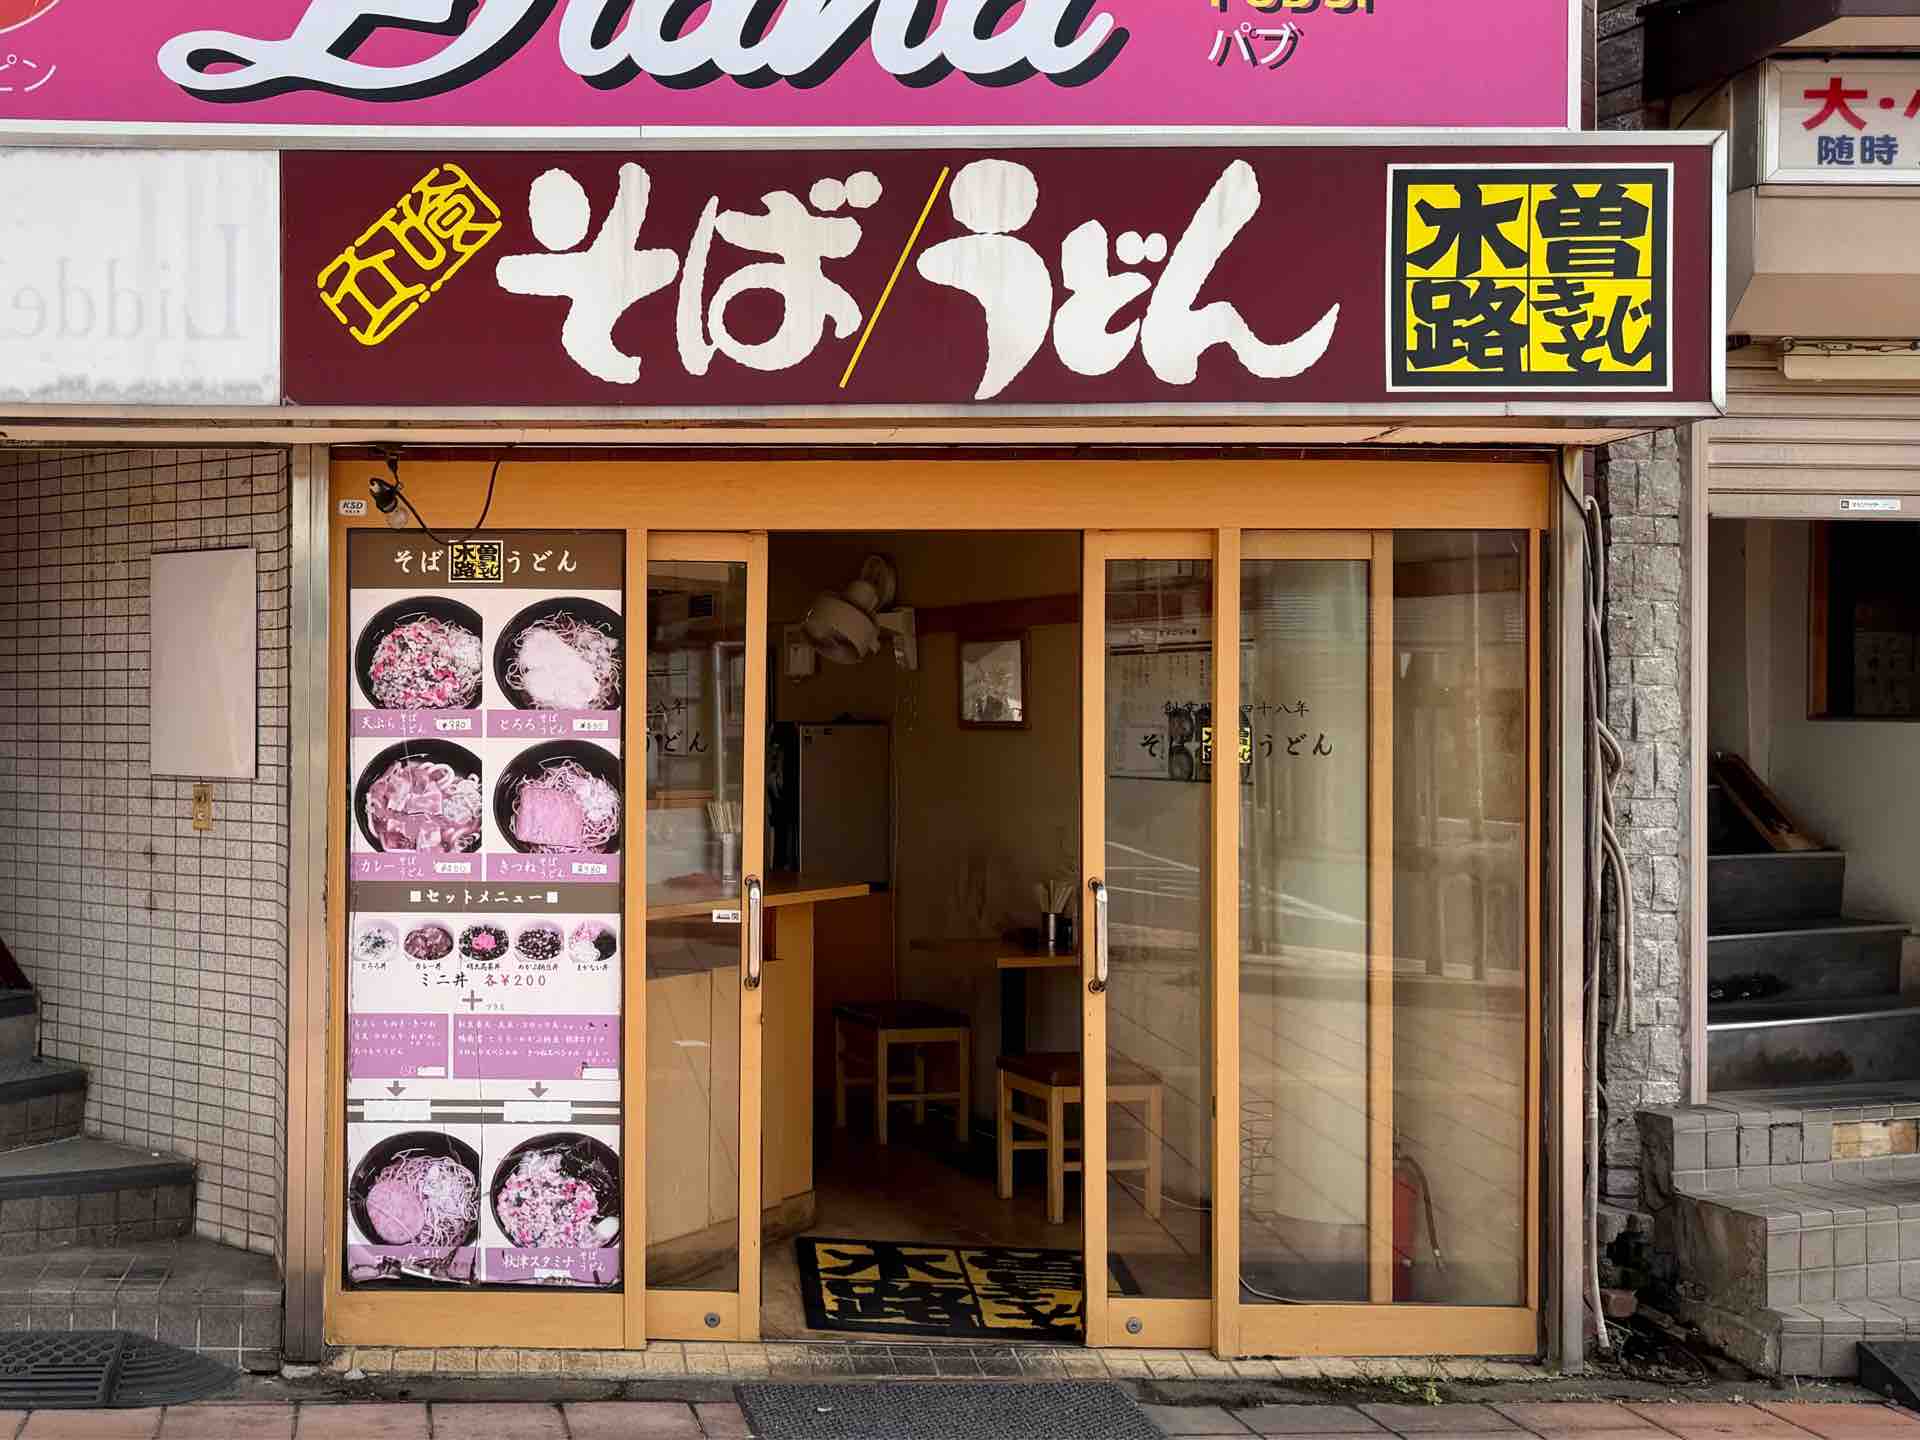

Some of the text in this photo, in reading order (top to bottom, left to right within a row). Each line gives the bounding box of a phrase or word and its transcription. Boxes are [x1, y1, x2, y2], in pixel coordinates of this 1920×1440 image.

[1207, 22, 1297, 66] パブ
[1817, 135, 1899, 165] 随時
[496, 162, 883, 384] そば
[916, 159, 1340, 400] うどん
[394, 551, 444, 574] そば
[506, 550, 577, 574] うどん
[1259, 734, 1333, 757] うどん
[361, 858, 395, 873] カレー
[499, 858, 537, 875] きつね
[426, 889, 543, 904] セットメニュー
[421, 971, 469, 988] ミニ丼
